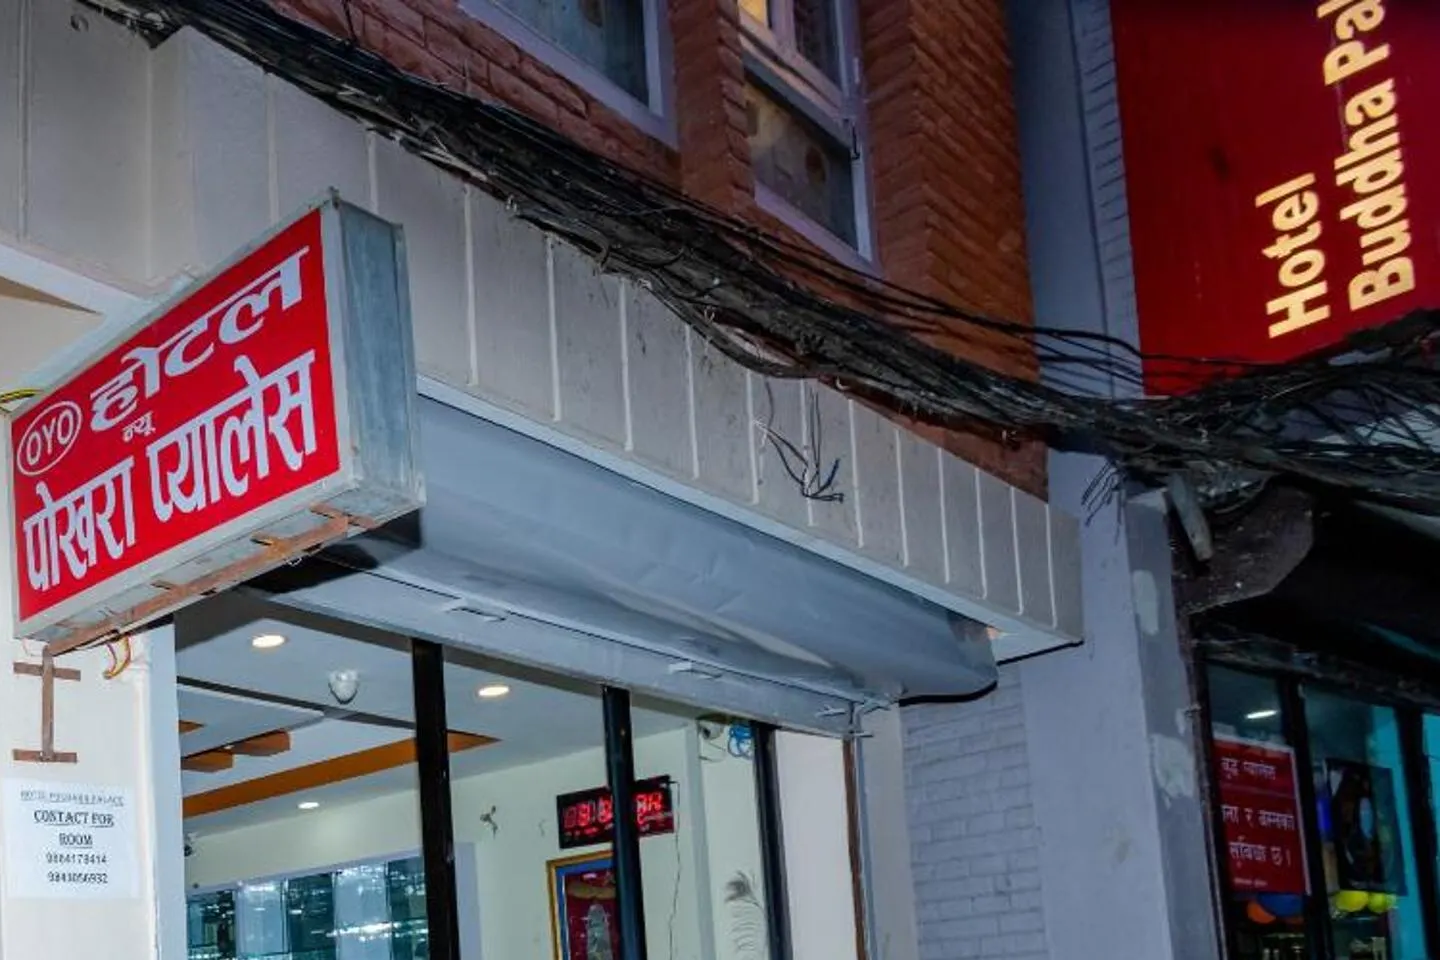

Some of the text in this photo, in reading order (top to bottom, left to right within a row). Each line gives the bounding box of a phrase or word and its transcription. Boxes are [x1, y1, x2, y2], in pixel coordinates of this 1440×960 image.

[1255, 172, 1331, 339] Hotel
[1334, 78, 1416, 312] Buddha
[89, 245, 310, 432] होटल
[23, 349, 317, 592] पोखरा प्यालेस
[25, 408, 73, 465] OYO
[33, 810, 88, 825] CONTACT
[58, 833, 93, 847] ROOM
